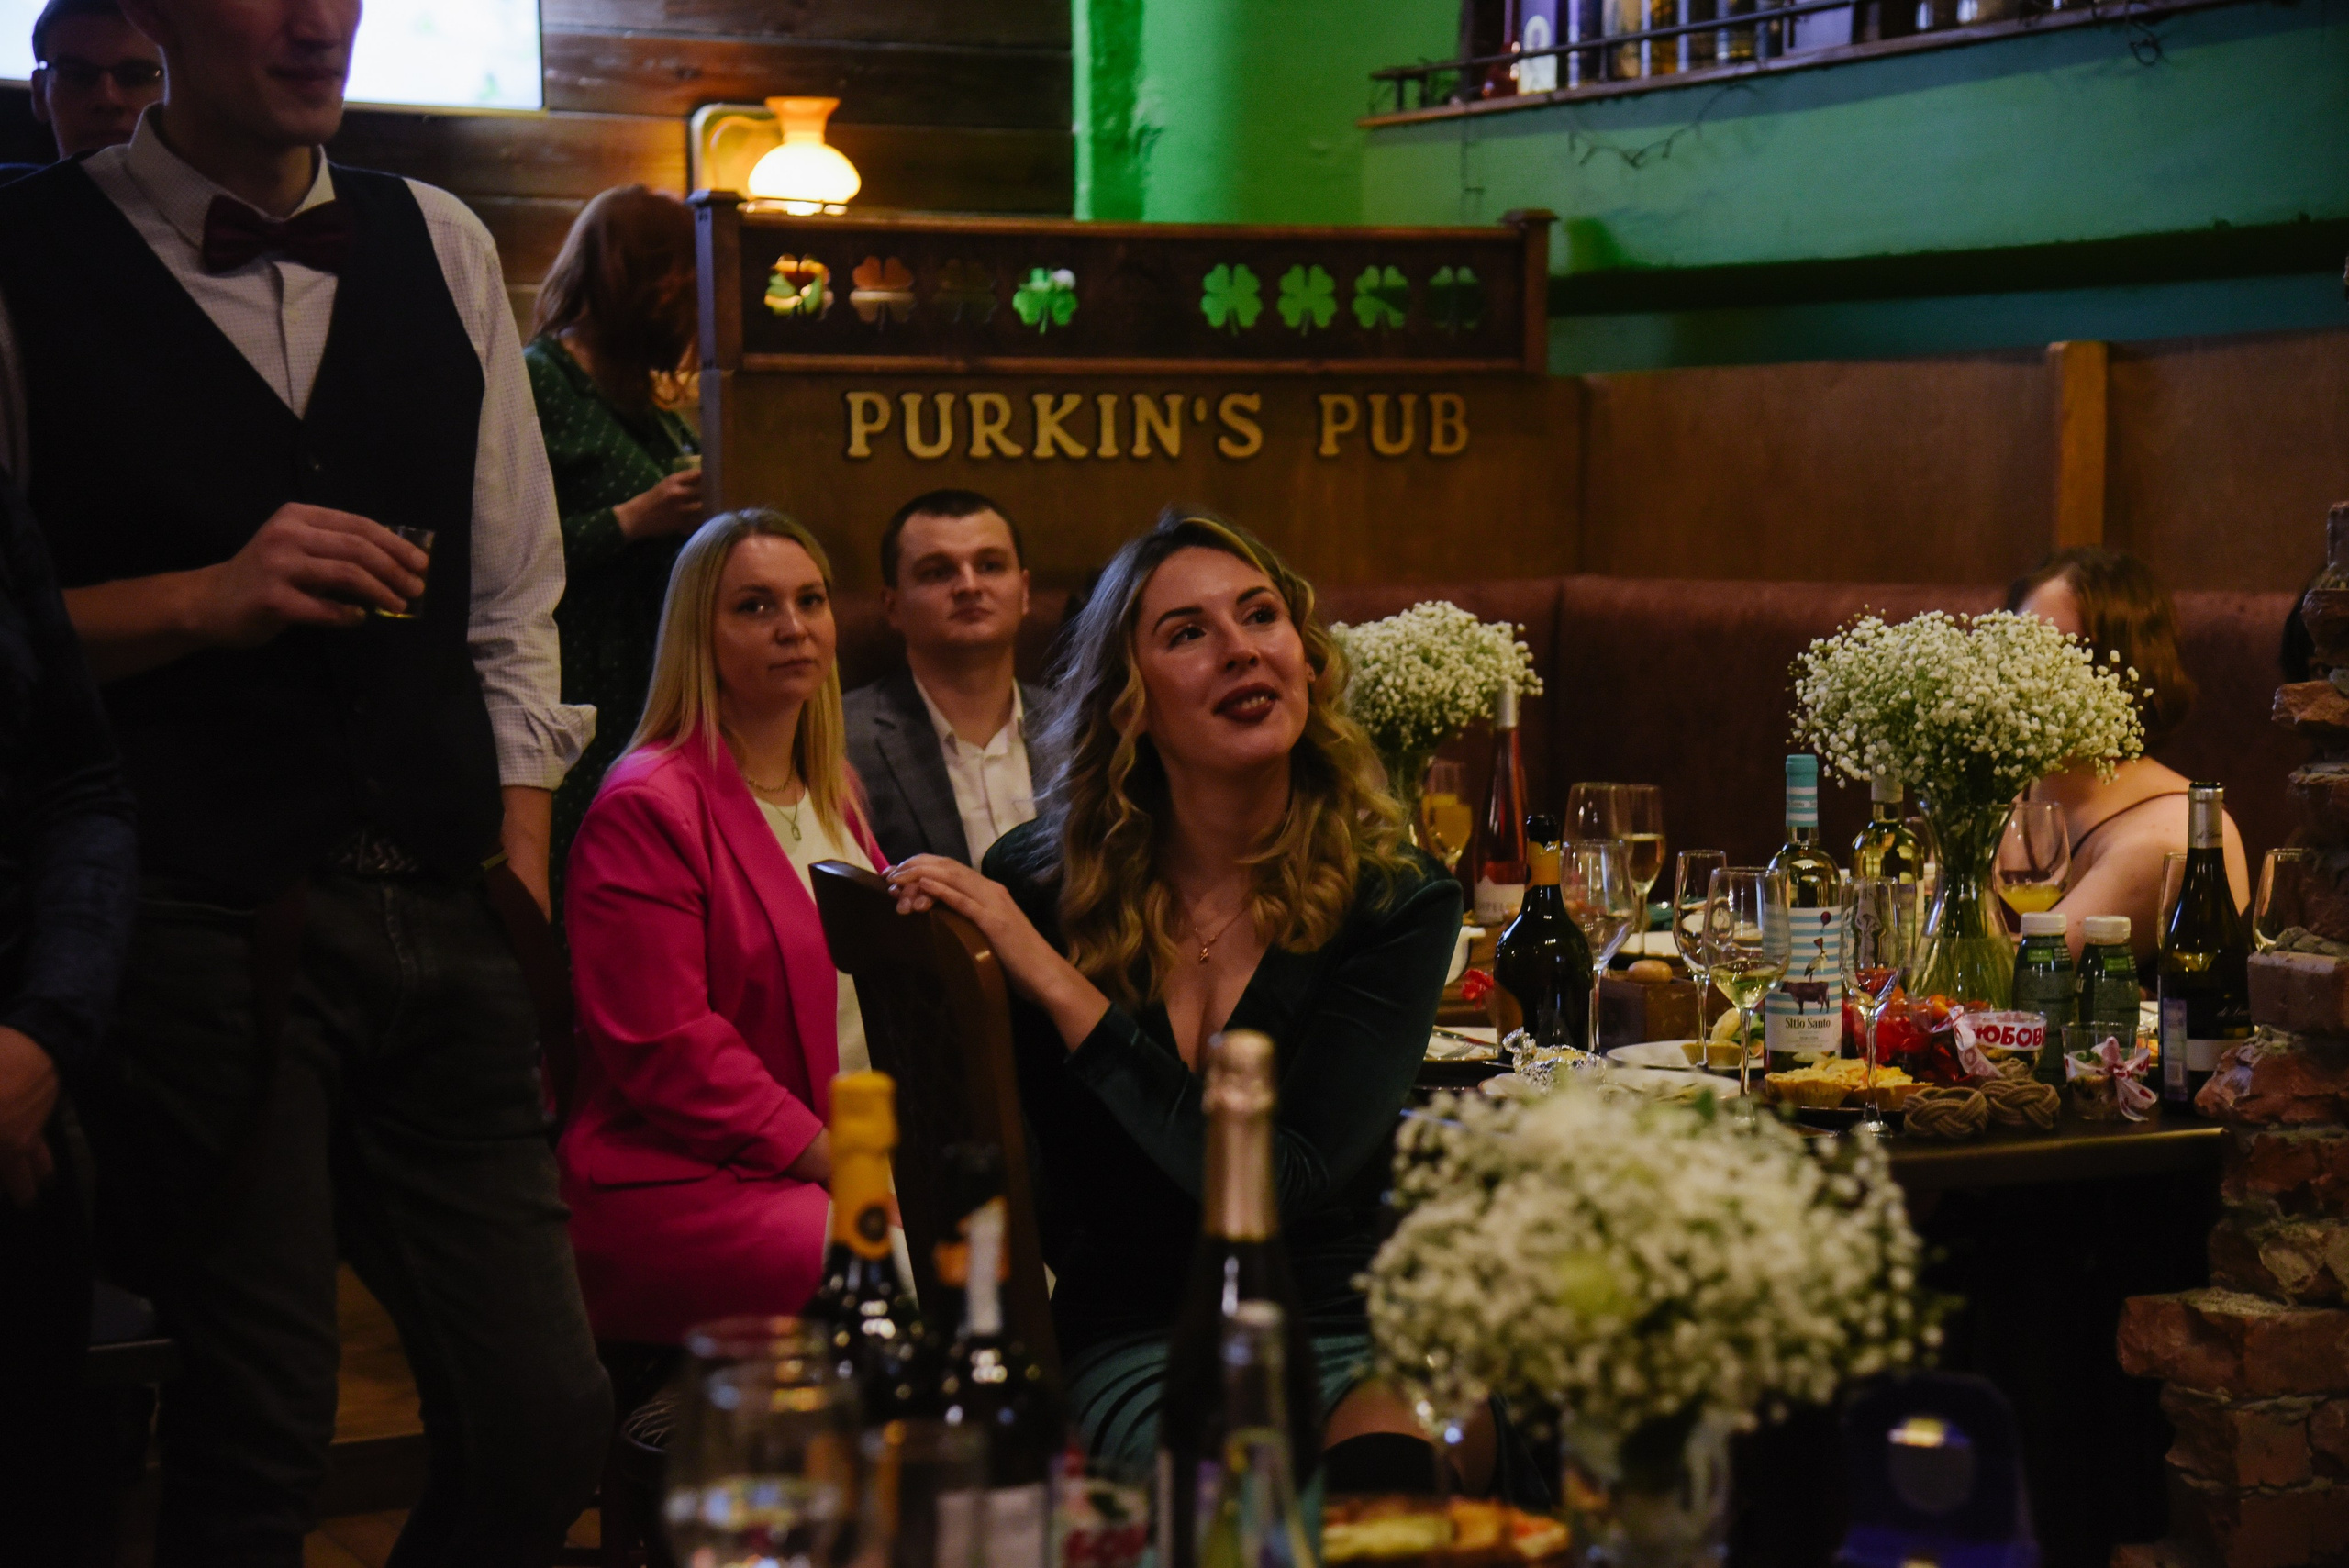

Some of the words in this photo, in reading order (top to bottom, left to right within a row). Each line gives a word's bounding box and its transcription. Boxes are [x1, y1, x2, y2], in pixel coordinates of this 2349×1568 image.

[846, 391, 1263, 458] PURKIN'S
[1318, 392, 1469, 456] PUB
[1807, 1017, 1831, 1029] Santo
[1973, 1024, 2046, 1048] ЮБОВ
